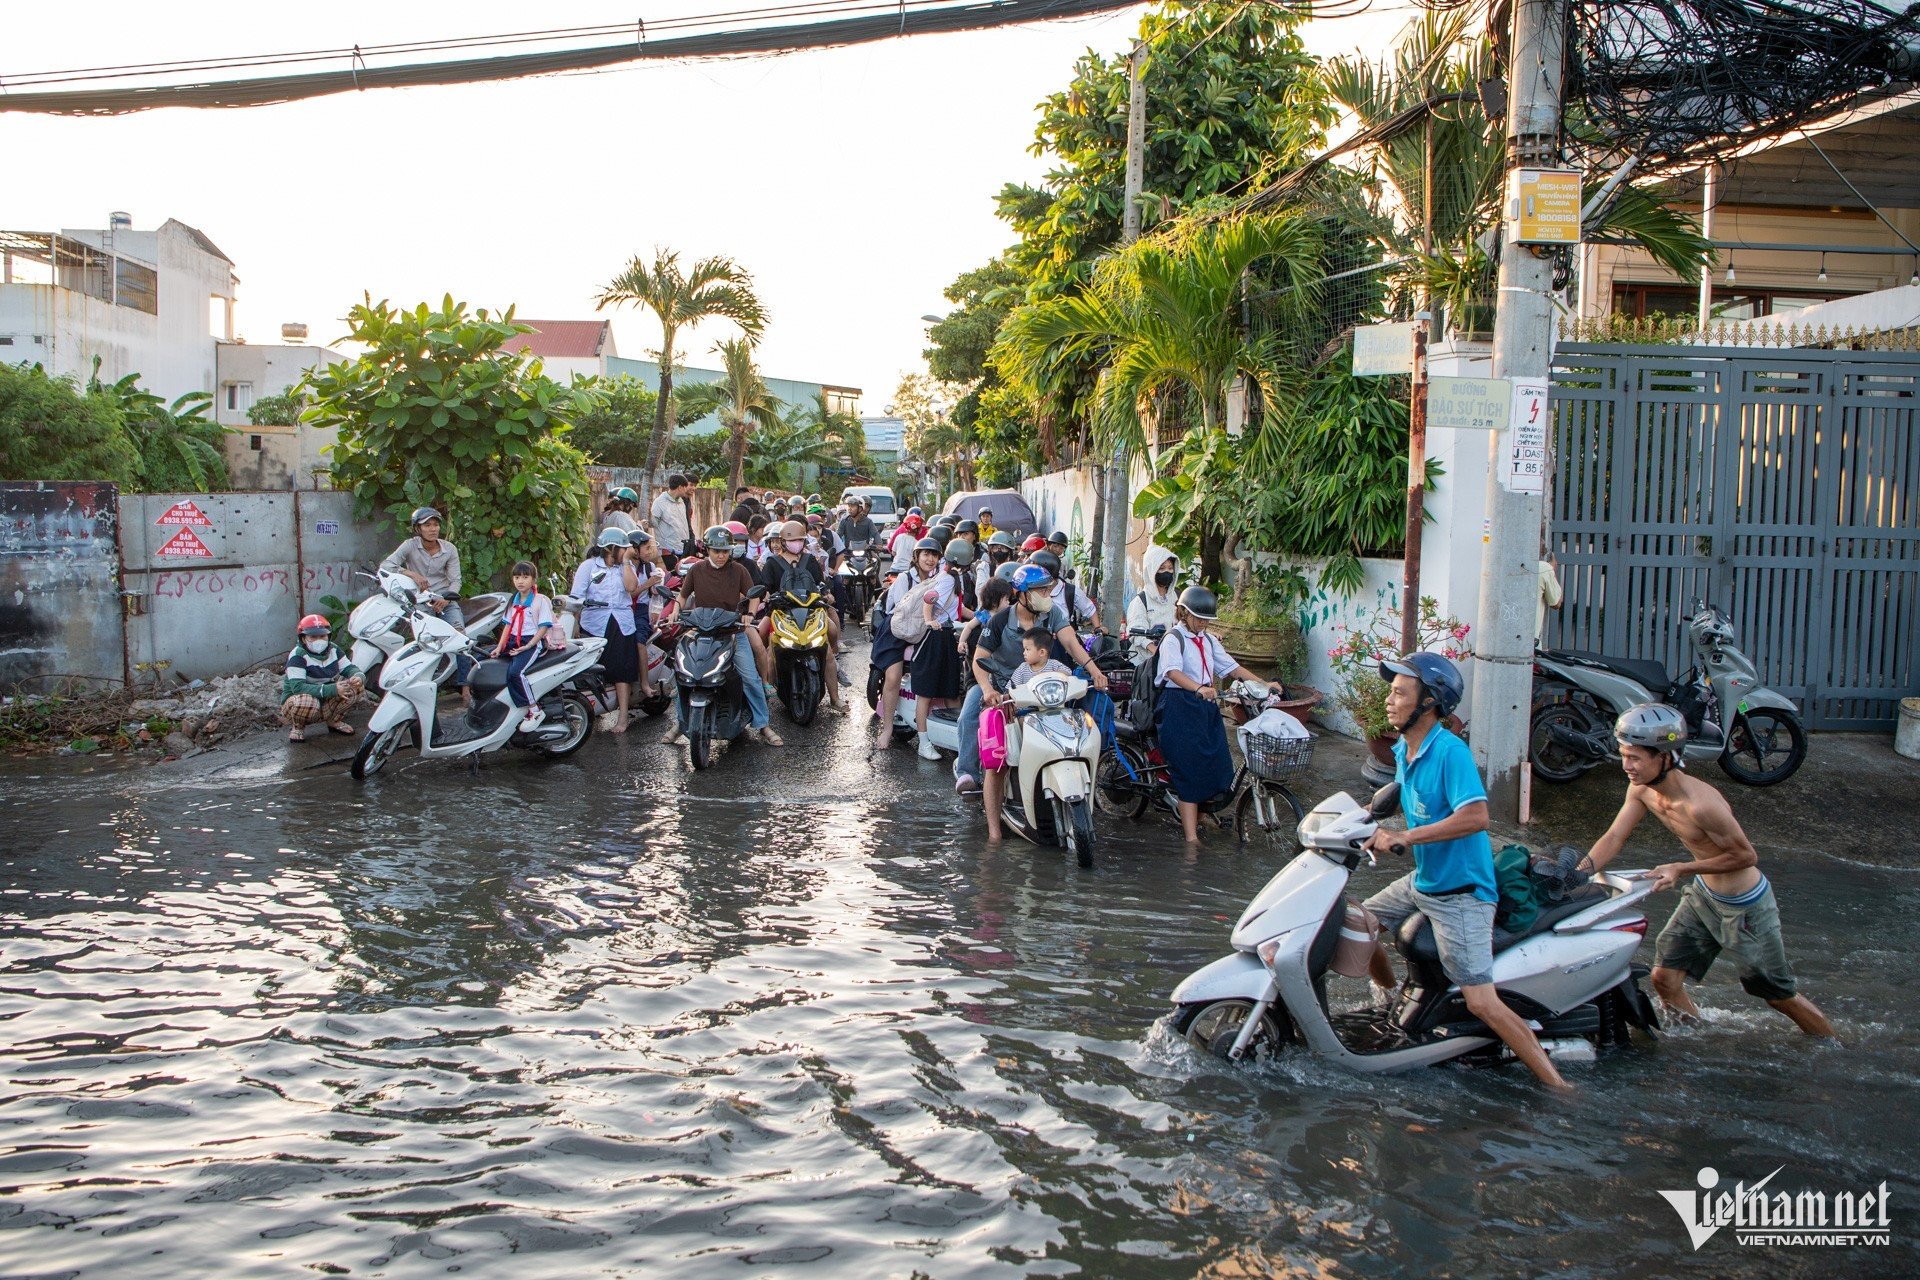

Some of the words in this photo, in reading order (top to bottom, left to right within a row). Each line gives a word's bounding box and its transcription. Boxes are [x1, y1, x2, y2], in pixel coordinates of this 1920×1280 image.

[1537, 183, 1578, 191] MESH-WIFI
[1451, 382, 1487, 396] ĐƯỜNG
[1431, 396, 1453, 415] ĐÀO
[1477, 399, 1504, 417] TÍCH
[1472, 418, 1483, 427] 25
[1513, 448, 1520, 458] J
[1513, 462, 1520, 472] T
[179, 532, 193, 541] BÁN
